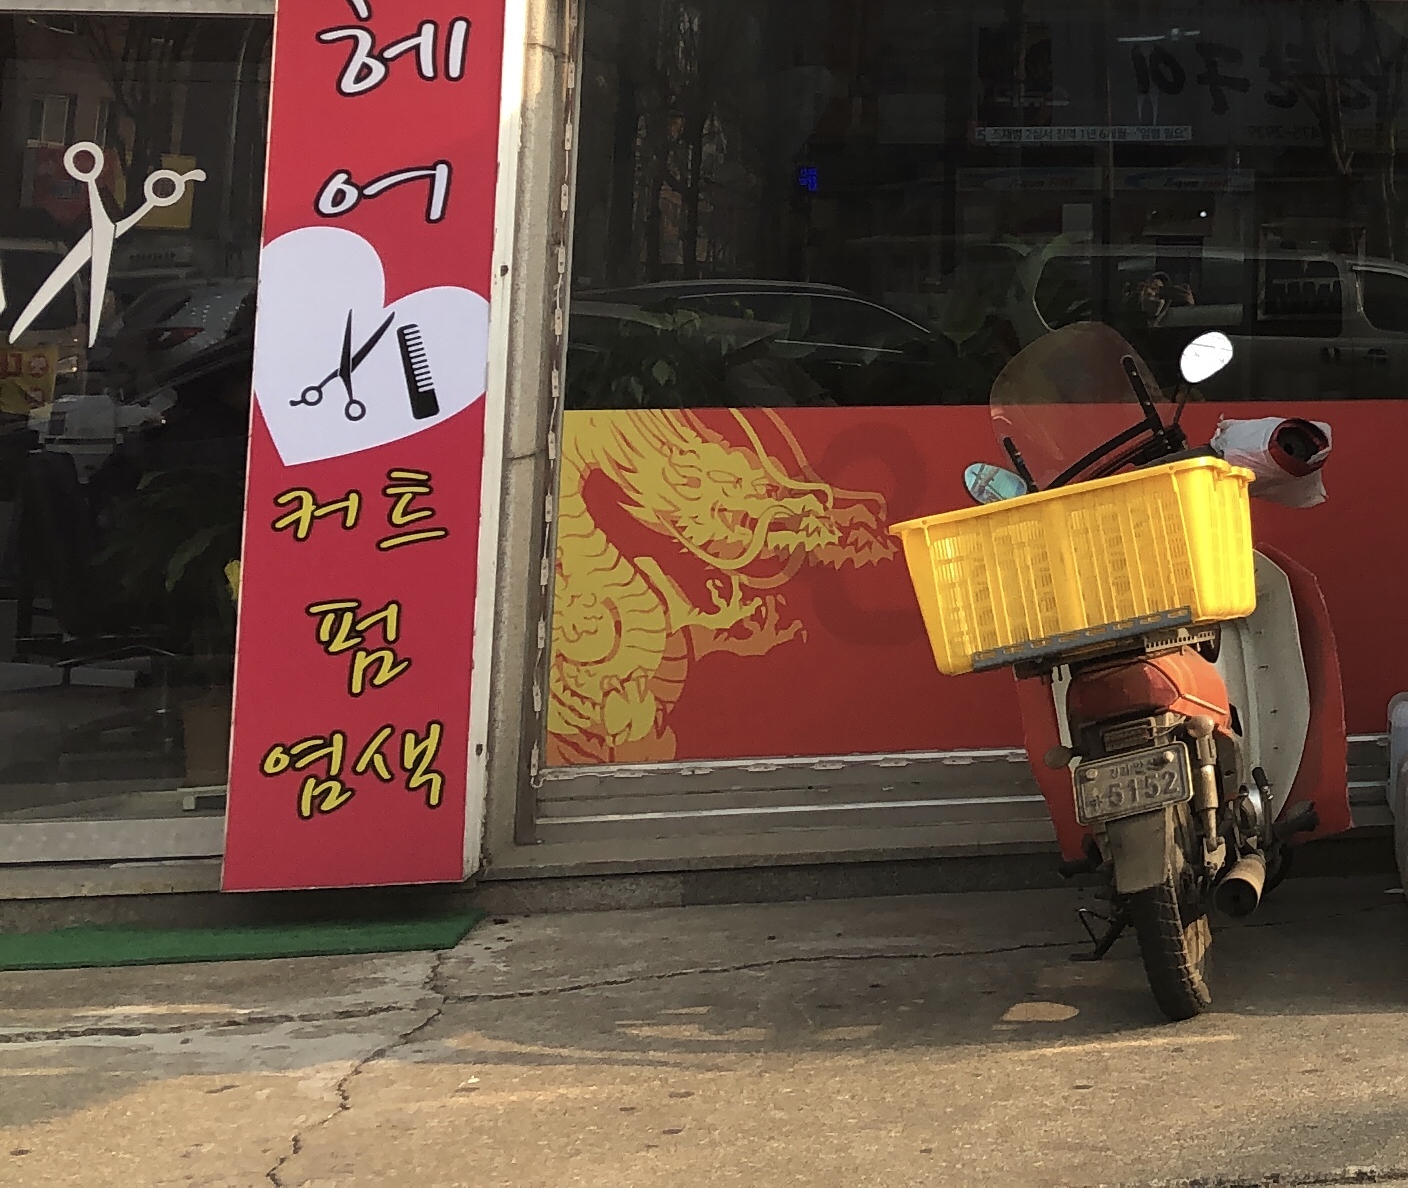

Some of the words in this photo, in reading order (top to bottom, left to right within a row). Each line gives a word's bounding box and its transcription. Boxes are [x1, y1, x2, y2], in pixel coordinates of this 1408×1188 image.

[272, 468, 448, 551] 커트
[306, 598, 410, 696] 펌
[260, 722, 445, 819] 염색
[1107, 770, 1181, 808] 5152
